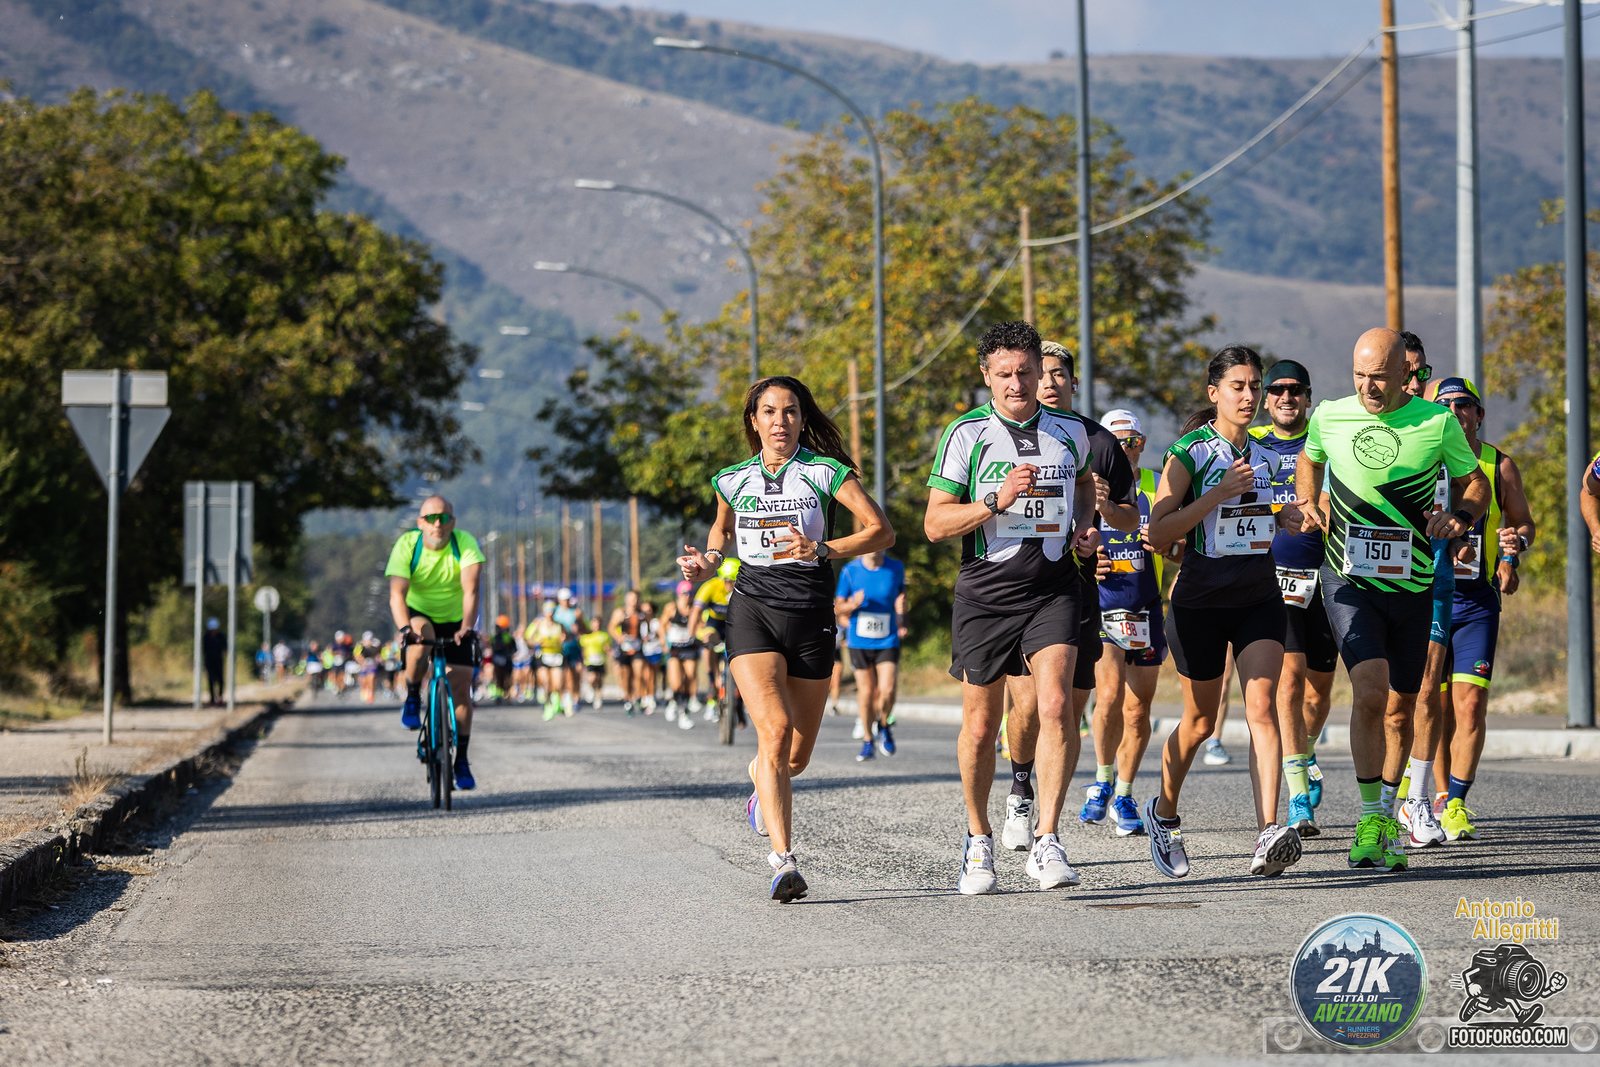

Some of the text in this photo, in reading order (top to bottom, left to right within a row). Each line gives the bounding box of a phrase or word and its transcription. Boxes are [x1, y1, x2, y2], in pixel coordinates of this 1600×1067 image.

[756, 496, 818, 512] AVEZZANO
[1271, 490, 1298, 504] udo
[1024, 500, 1045, 518] 68
[747, 519, 760, 528] 21K
[1237, 518, 1256, 537] 64
[761, 530, 777, 548] 61
[1358, 529, 1374, 538] 21K
[1365, 541, 1391, 560] 150
[1279, 577, 1297, 593] 06
[1120, 622, 1137, 637] 188
